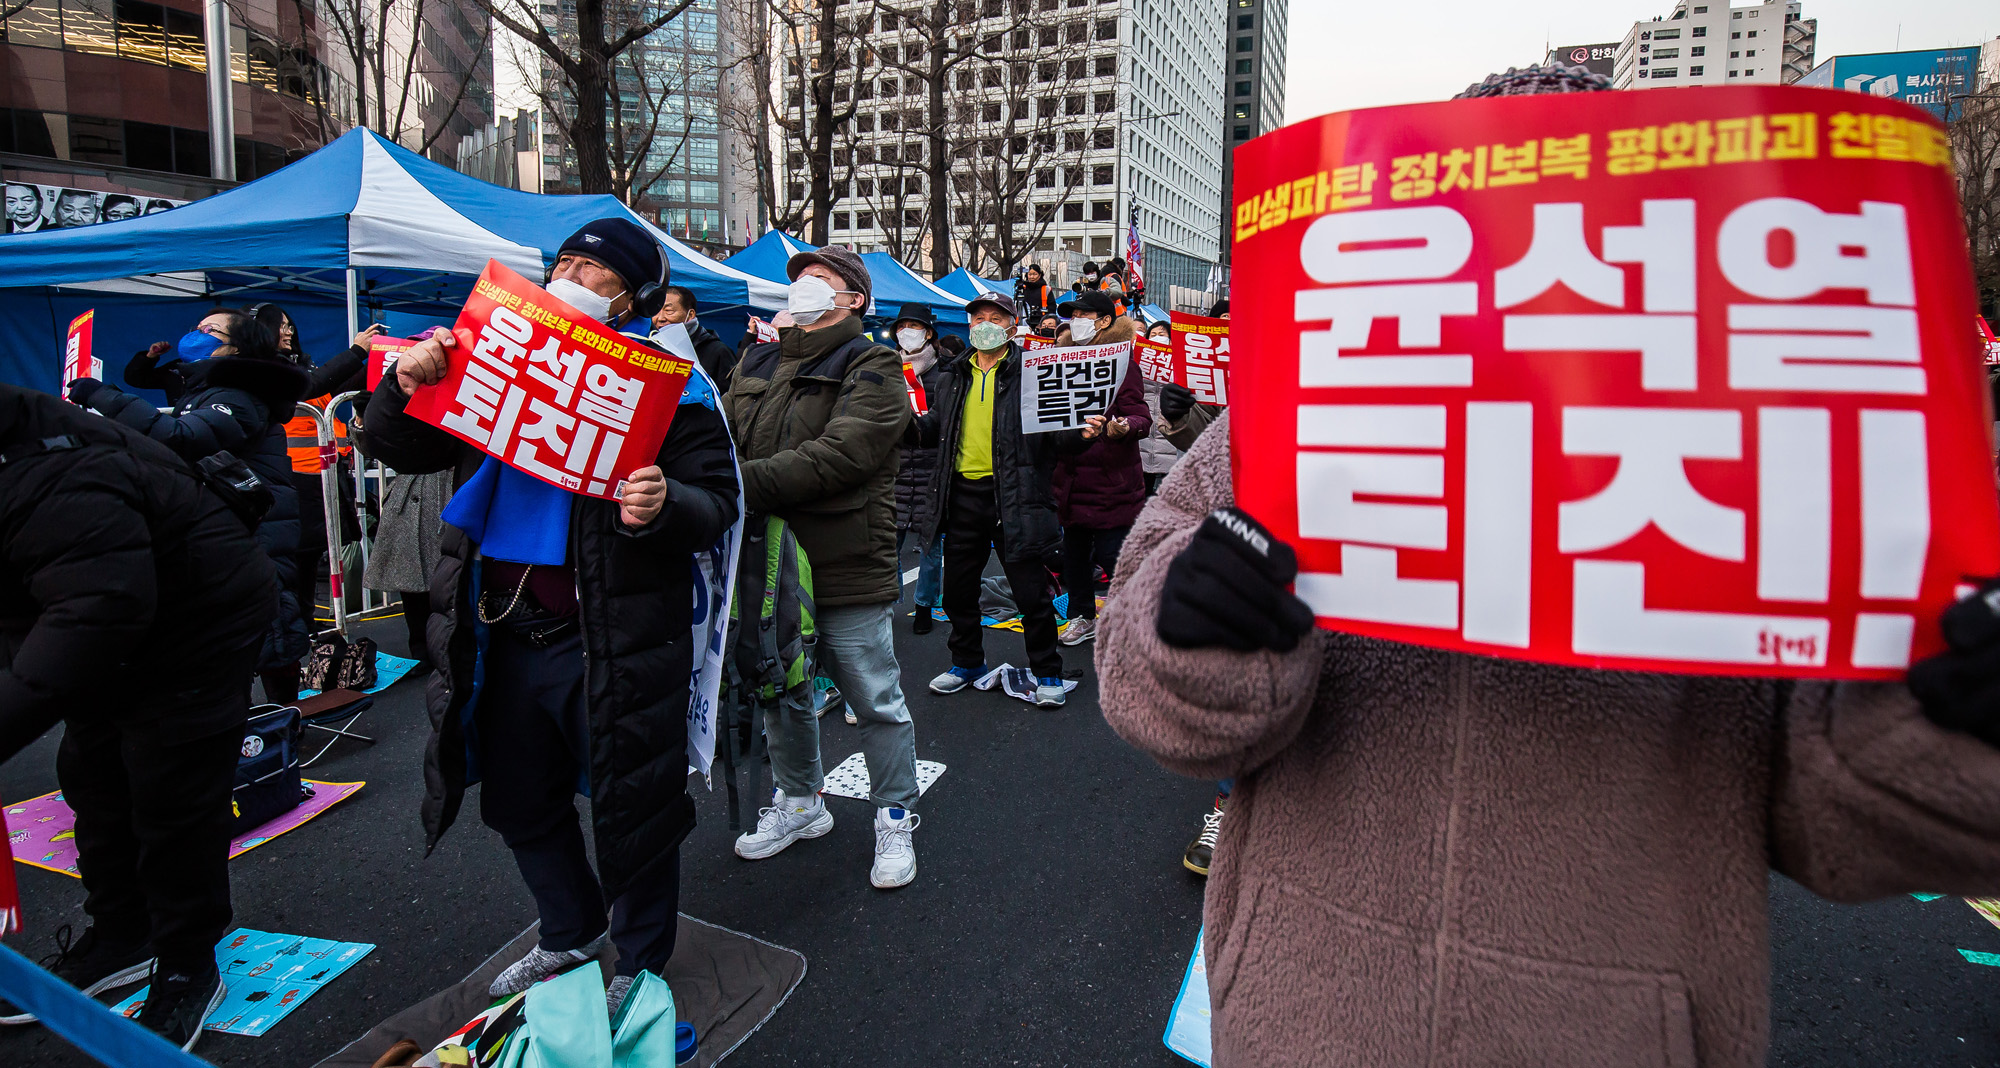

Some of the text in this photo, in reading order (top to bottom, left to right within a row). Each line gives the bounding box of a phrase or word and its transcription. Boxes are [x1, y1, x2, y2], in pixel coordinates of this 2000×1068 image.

[1639, 30, 1652, 78] 삼정빌딩
[1906, 73, 1965, 87] 복사지는
[1235, 162, 1377, 243] 민생파탄
[1390, 133, 1592, 202] 정치보복
[1606, 112, 1818, 176] 평화파괴
[475, 279, 692, 378] 민생파탄 정치보복 평화파괴 친일매국
[1294, 198, 1928, 395] 윤석열
[472, 305, 646, 433] 윤석열
[1024, 354, 1059, 369] 주가조작
[1060, 349, 1098, 363] 허위경력
[1098, 342, 1130, 358] 상습사기
[1037, 358, 1118, 392] 김건희
[1140, 347, 1174, 369] 윤석
[440, 360, 626, 496] 퇴진!
[1295, 400, 1931, 668] 퇴진!
